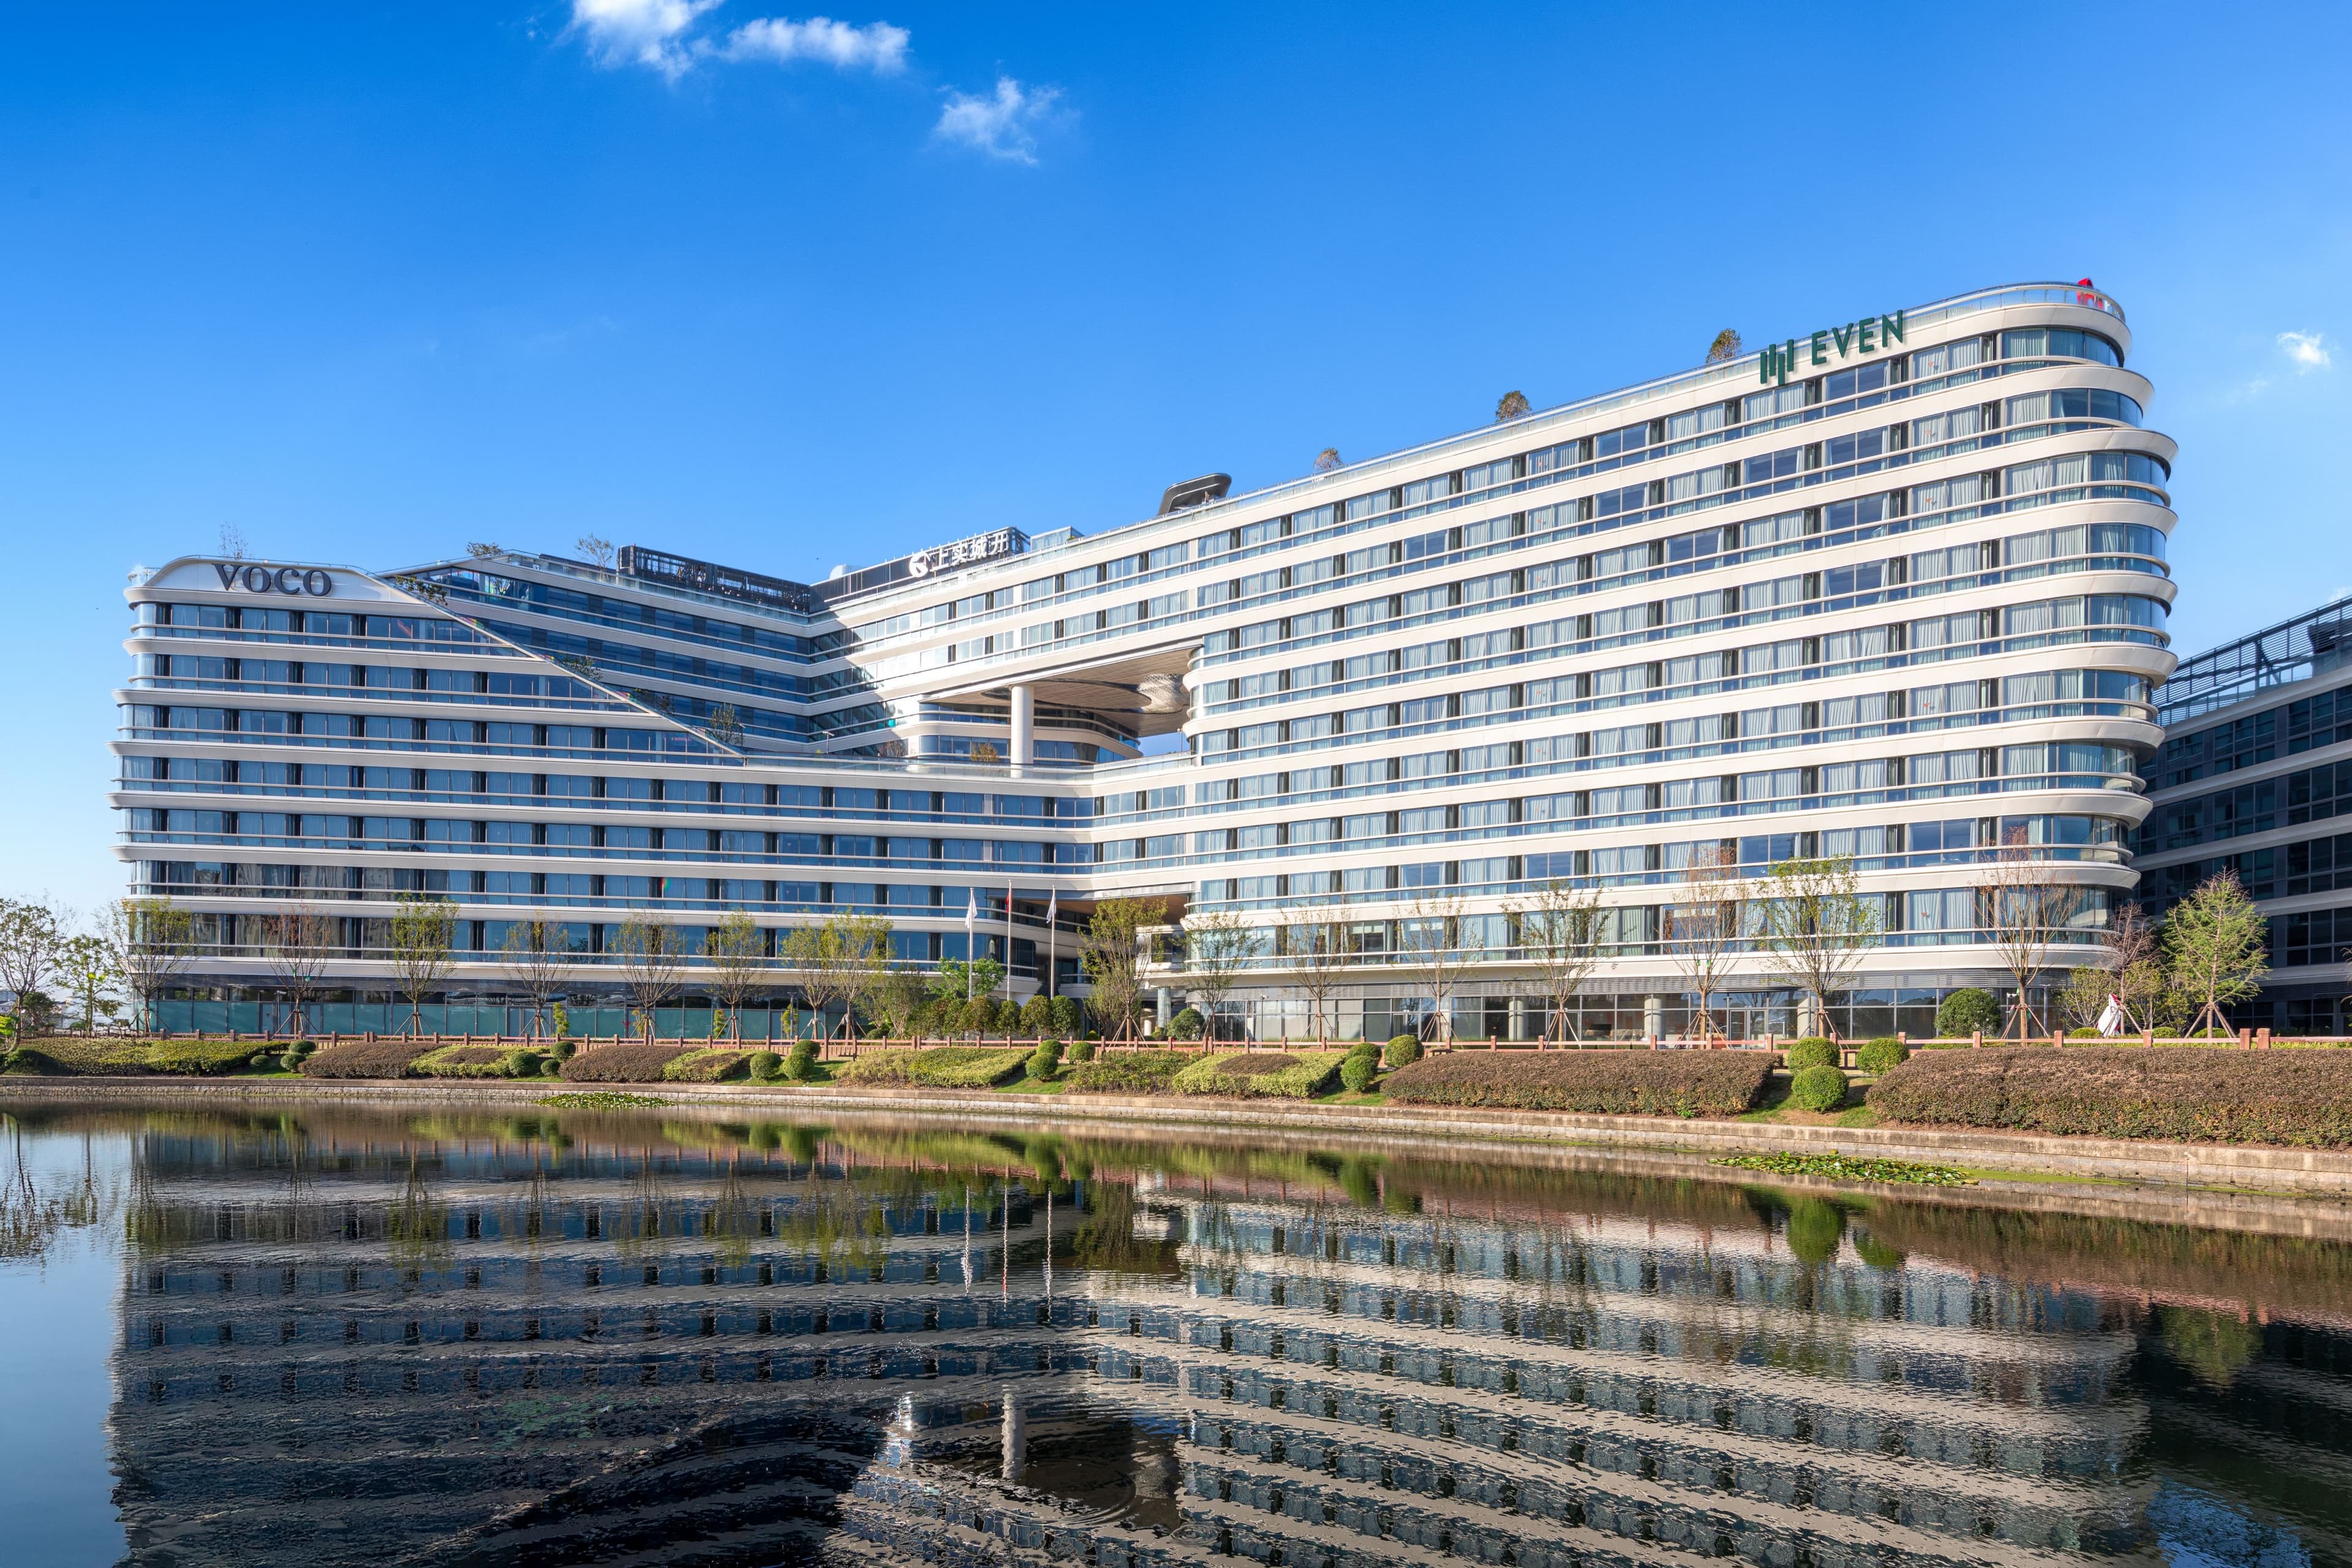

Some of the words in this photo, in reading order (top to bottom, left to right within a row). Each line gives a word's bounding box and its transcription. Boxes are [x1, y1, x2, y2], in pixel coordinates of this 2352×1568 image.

[1812, 309, 1903, 366] EVEN
[930, 530, 1009, 572] 上实城开
